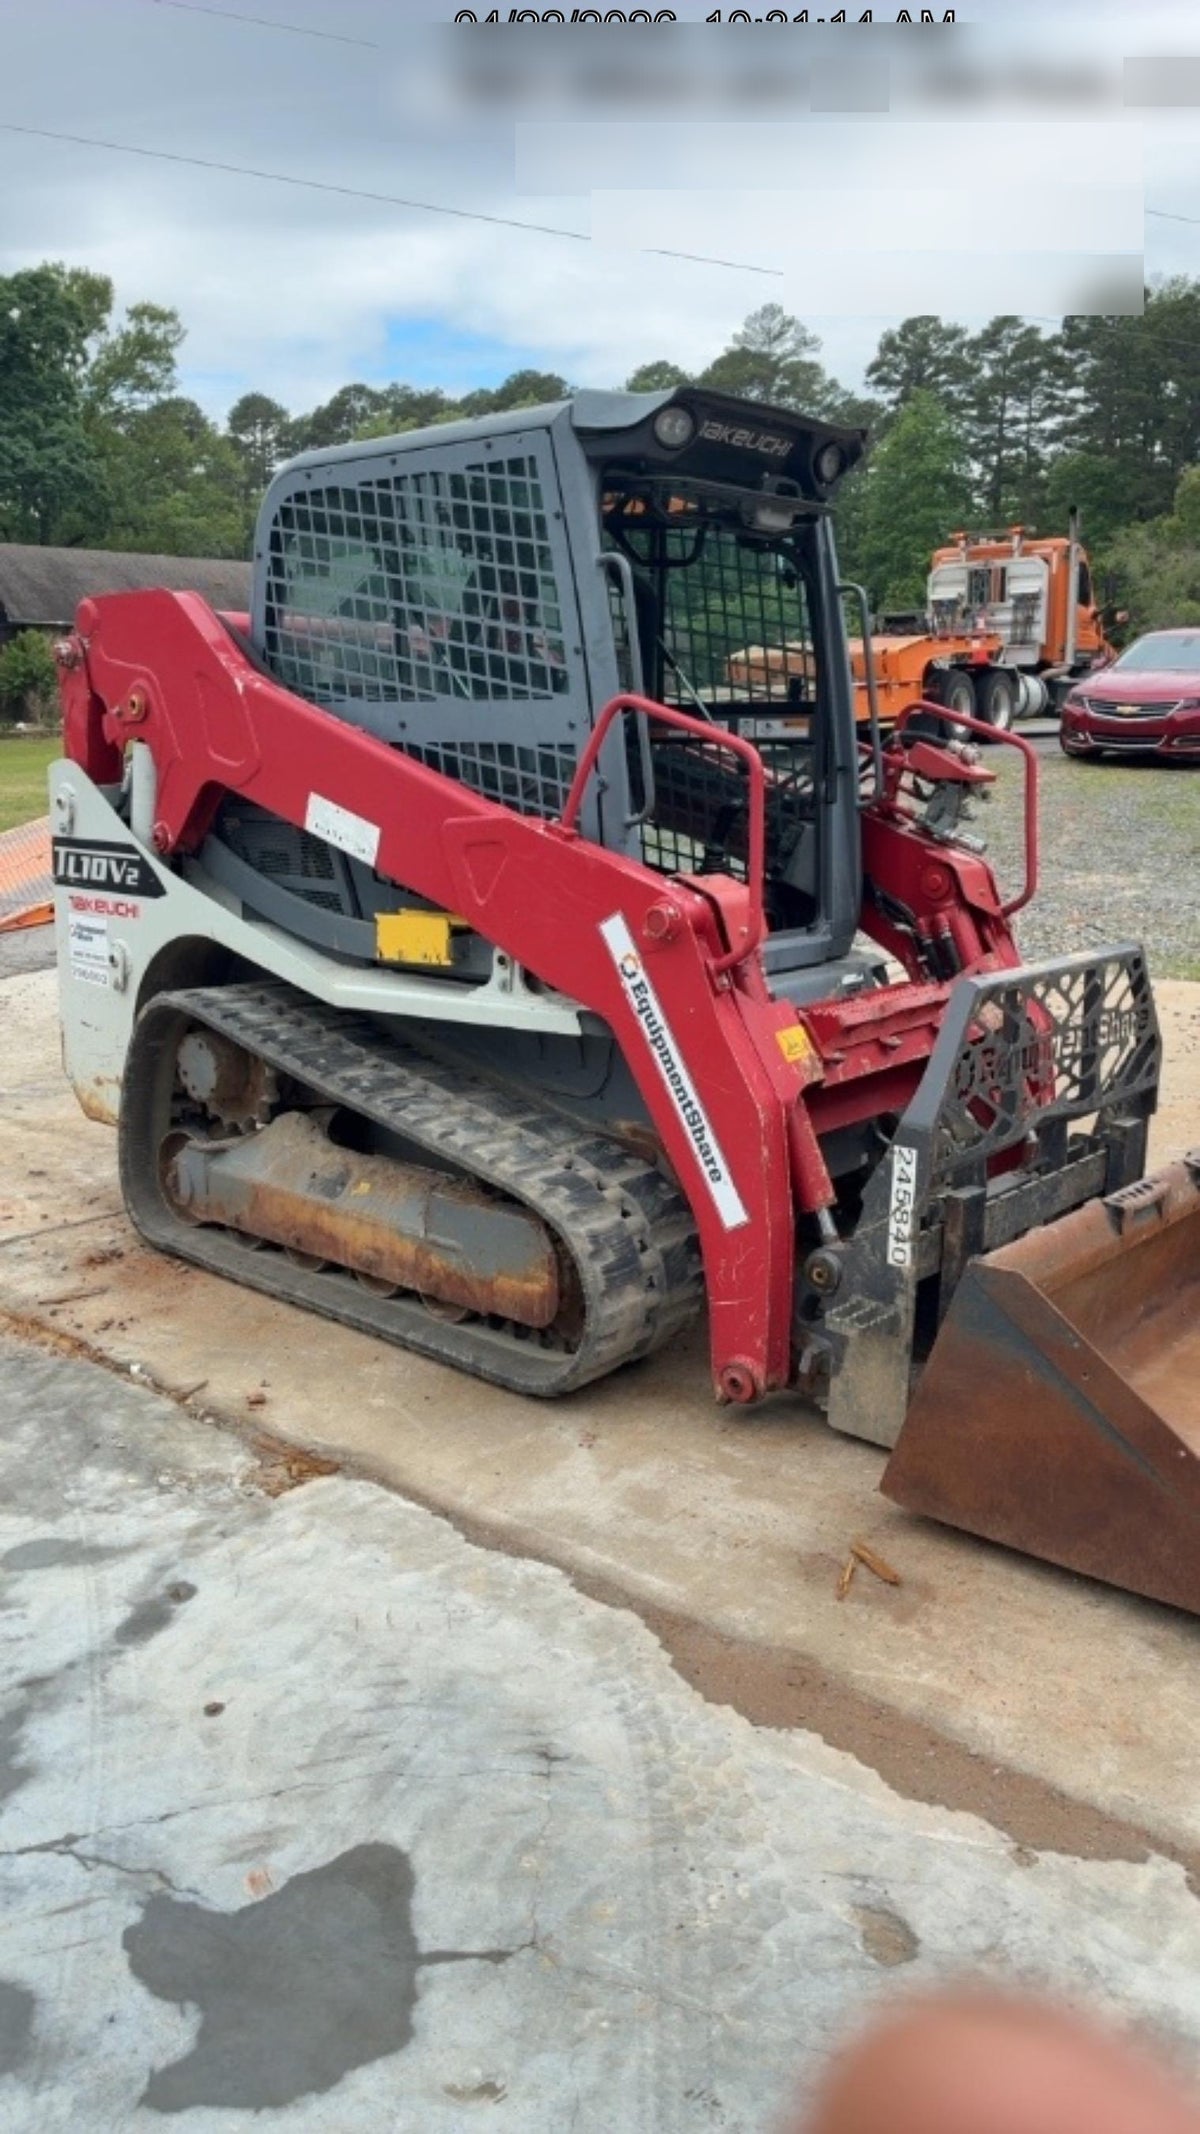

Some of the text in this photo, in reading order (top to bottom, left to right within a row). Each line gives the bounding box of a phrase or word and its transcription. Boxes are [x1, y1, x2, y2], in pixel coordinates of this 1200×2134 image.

[54, 846, 140, 885] TL10V2
[631, 979, 723, 1184] EquipmentShare
[892, 1149, 914, 1265] 245840
